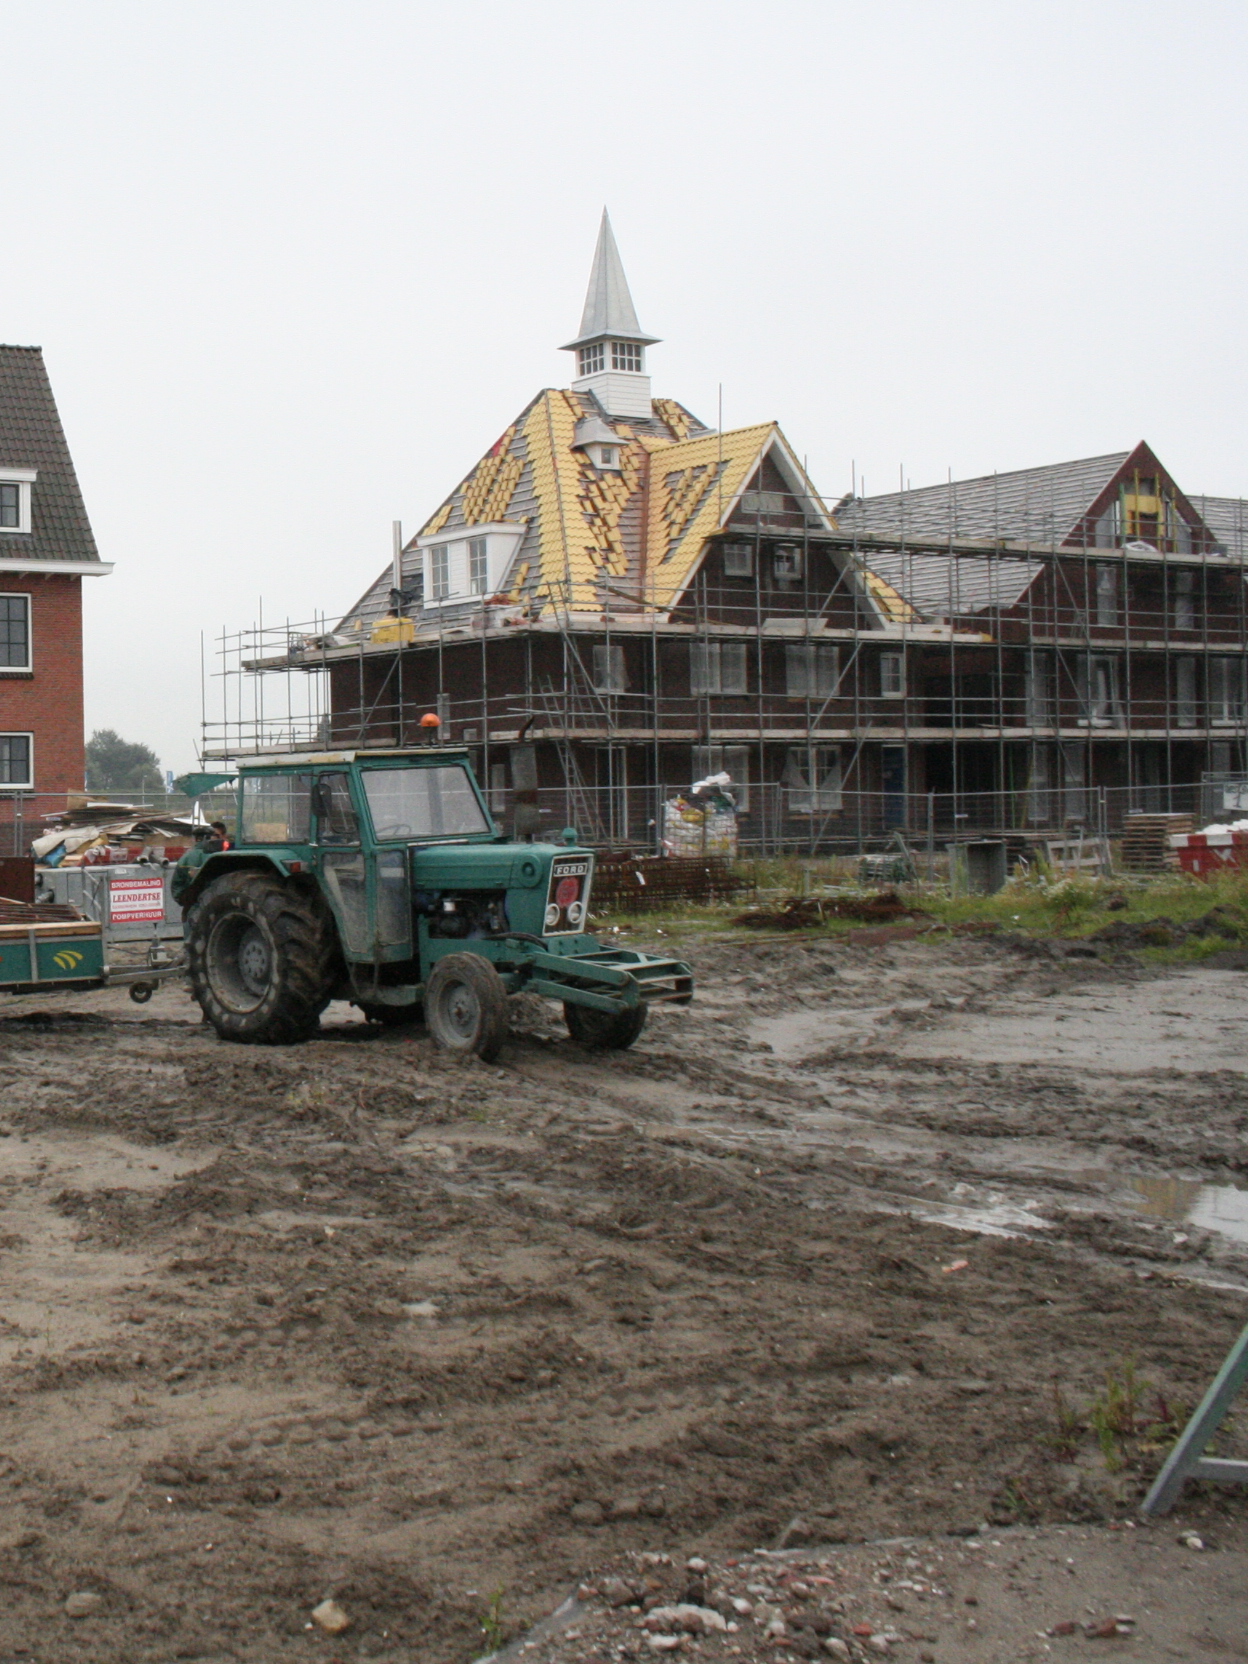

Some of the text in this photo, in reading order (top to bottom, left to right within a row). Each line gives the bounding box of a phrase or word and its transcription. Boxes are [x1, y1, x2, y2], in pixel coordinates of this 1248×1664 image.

[556, 865, 584, 875] FORD
[111, 879, 161, 889] BRONBEMALING
[112, 892, 161, 903] LEENDERTSE
[112, 911, 162, 921] POMPVERHUUR
